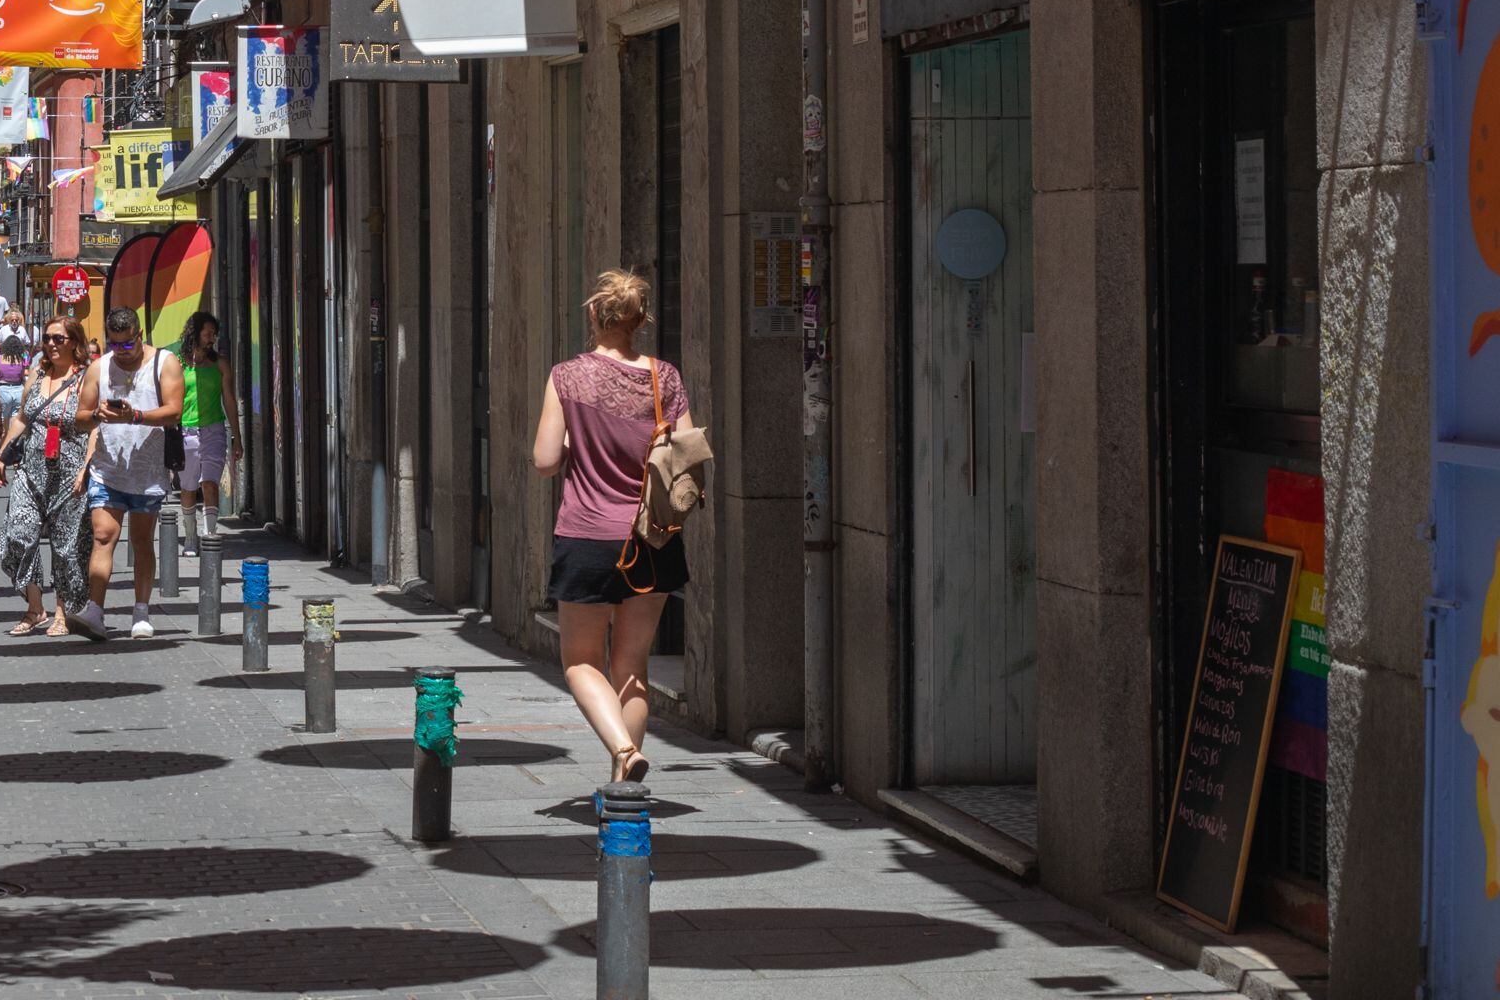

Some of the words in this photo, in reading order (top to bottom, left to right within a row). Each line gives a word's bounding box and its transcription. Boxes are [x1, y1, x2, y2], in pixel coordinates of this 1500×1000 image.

[66, 47, 100, 55] Comunidad
[76, 53, 99, 61] Madrid
[255, 55, 311, 68] RESTAURANTE
[255, 67, 312, 88] CUBANO
[117, 145, 125, 154] a
[128, 140, 184, 154] different
[123, 205, 152, 214] TIENDA
